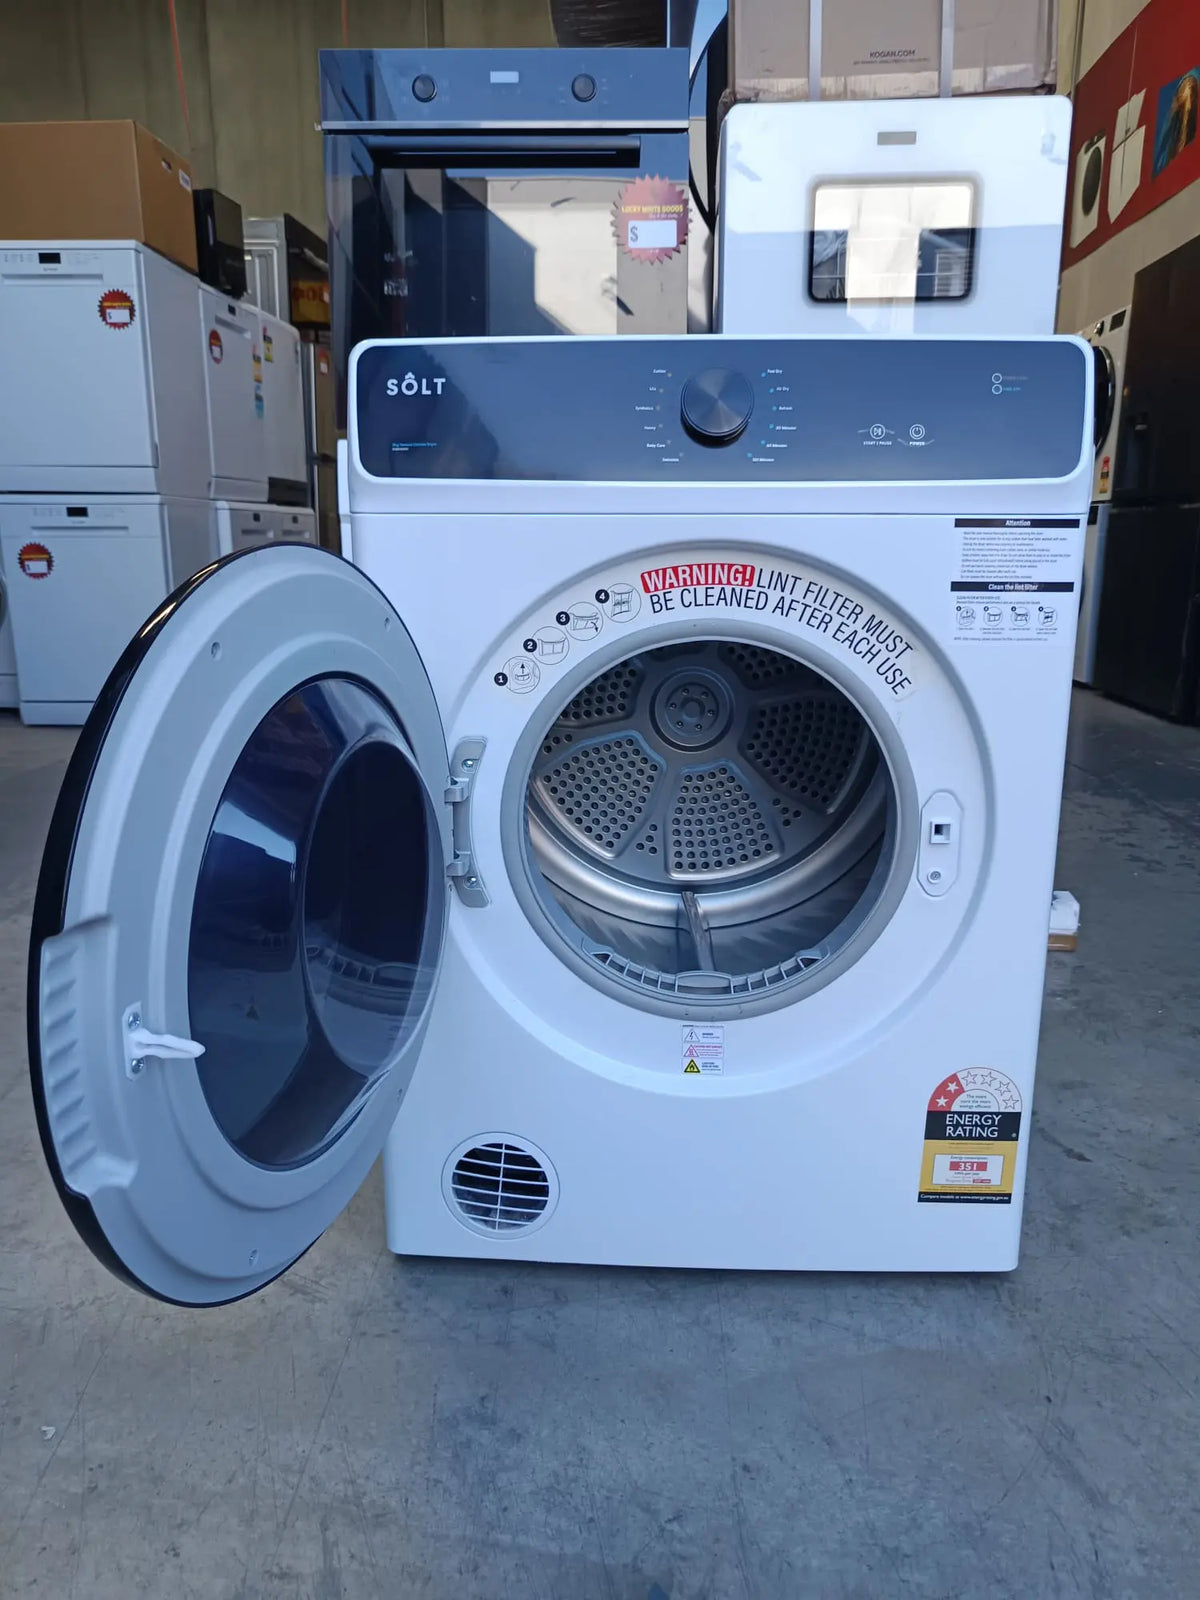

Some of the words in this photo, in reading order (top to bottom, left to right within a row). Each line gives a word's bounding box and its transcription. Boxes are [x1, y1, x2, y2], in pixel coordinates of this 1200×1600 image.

[869, 49, 916, 59] KOGAN.COM
[630, 225, 639, 242] $
[988, 583, 1004, 591] Clean
[643, 564, 752, 593] WARNING!
[756, 568, 802, 596] LINT
[803, 581, 864, 624] FILTER
[861, 614, 914, 659] MUST
[650, 591, 675, 614] BE
[680, 586, 769, 610] CLEANED
[772, 596, 833, 633] AFTER
[832, 622, 882, 664] EACH
[876, 657, 912, 695] USE
[945, 1114, 1002, 1126] ENERGY
[945, 1126, 999, 1138] RATING
[958, 1162, 977, 1171] 351
